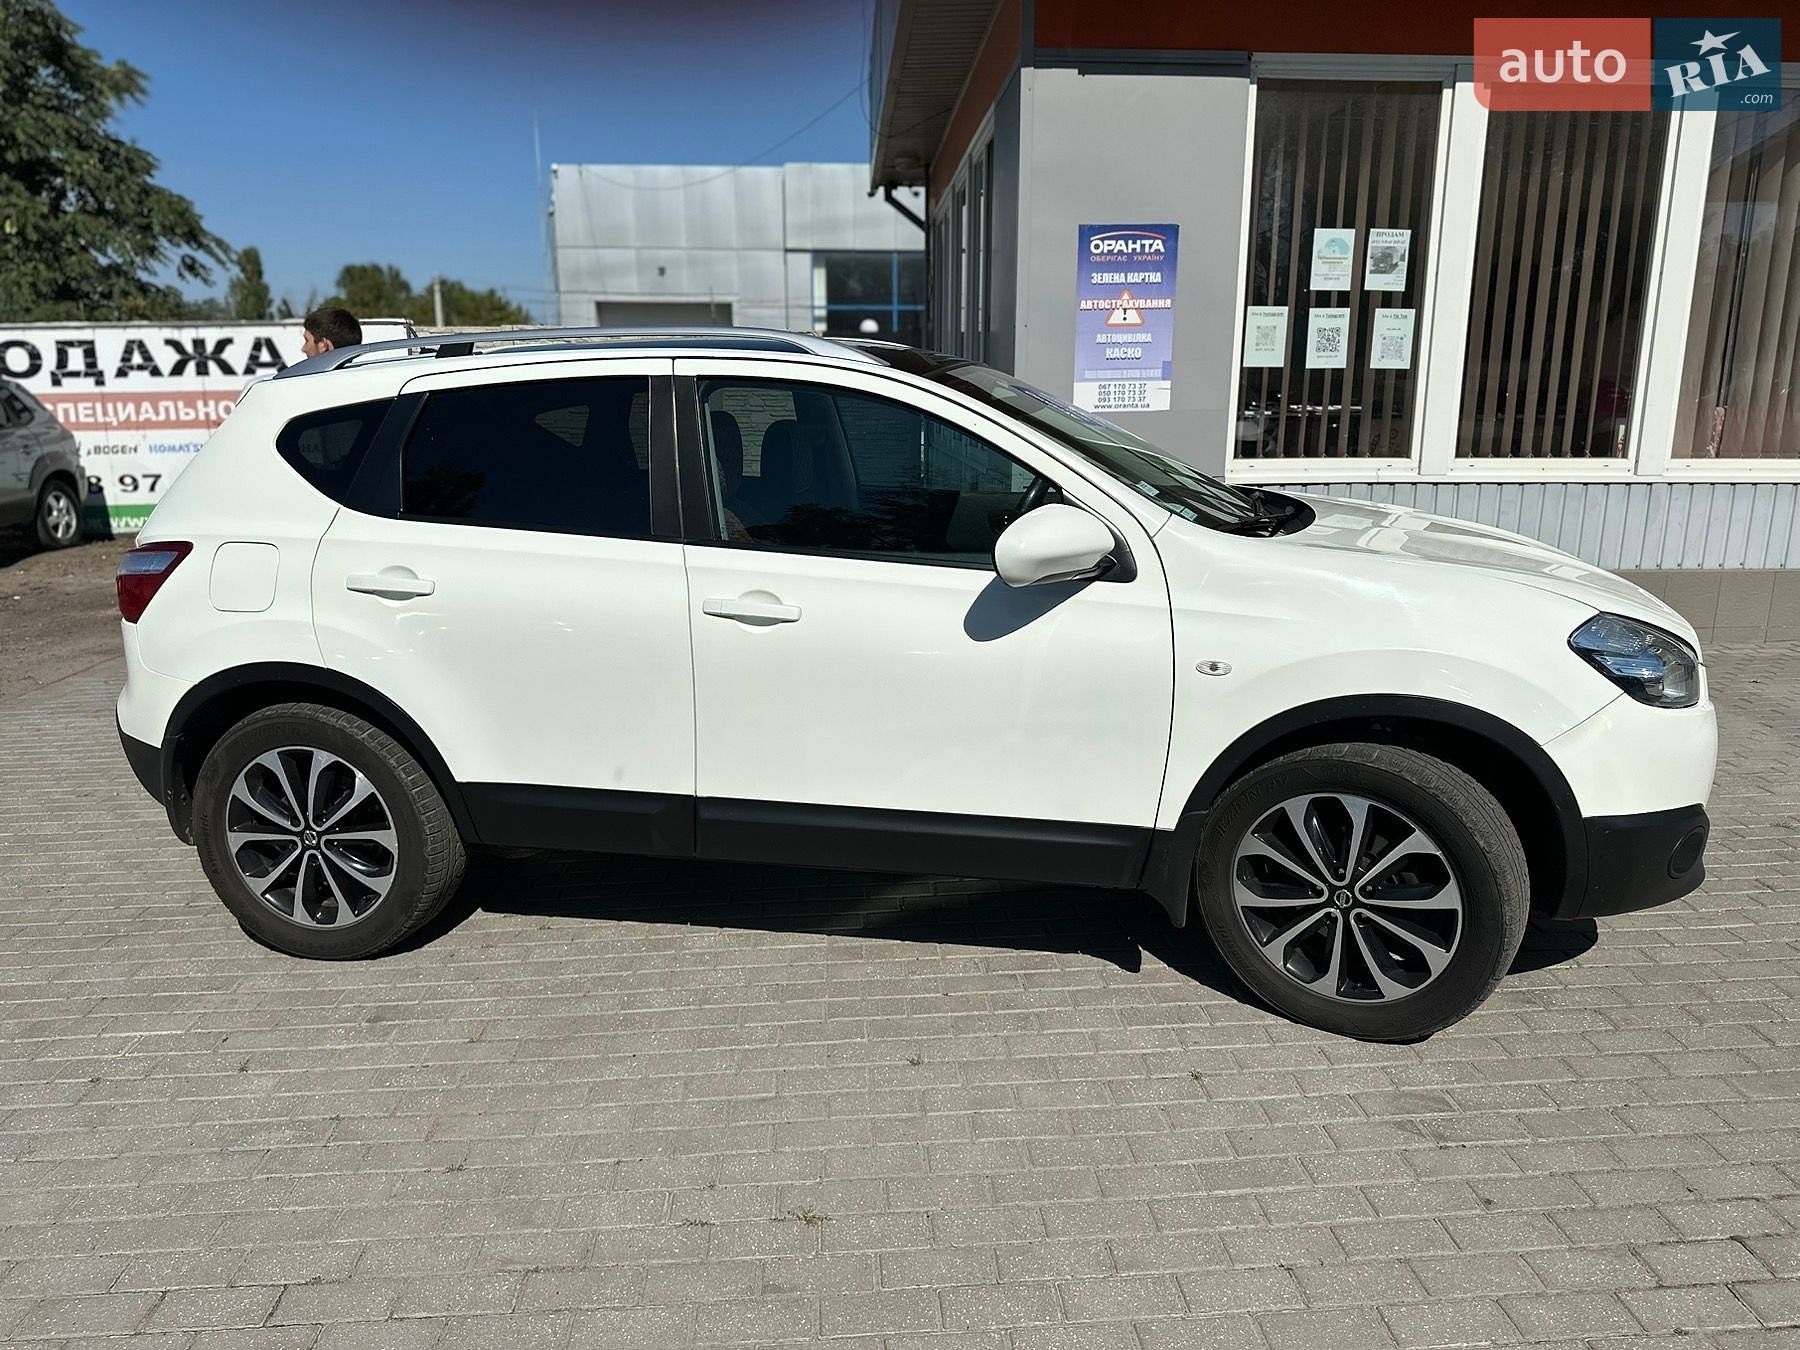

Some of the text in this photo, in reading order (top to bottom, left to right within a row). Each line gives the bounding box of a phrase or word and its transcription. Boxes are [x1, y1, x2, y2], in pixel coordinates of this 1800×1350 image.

[1090, 240, 1165, 254] ОРАНТА
[1091, 271, 1162, 285] ЗЕЛЕНА КАРТКА
[1080, 298, 1172, 311] АВТОСТРАХУВАННЯ
[1096, 333, 1153, 345] АВТОЦИВІЛКА
[1105, 347, 1142, 360] КАСКО
[44, 399, 236, 426] ПЕЦИАЛЬНО
[149, 442, 204, 454] KOMATS
[118, 474, 162, 493] 97
